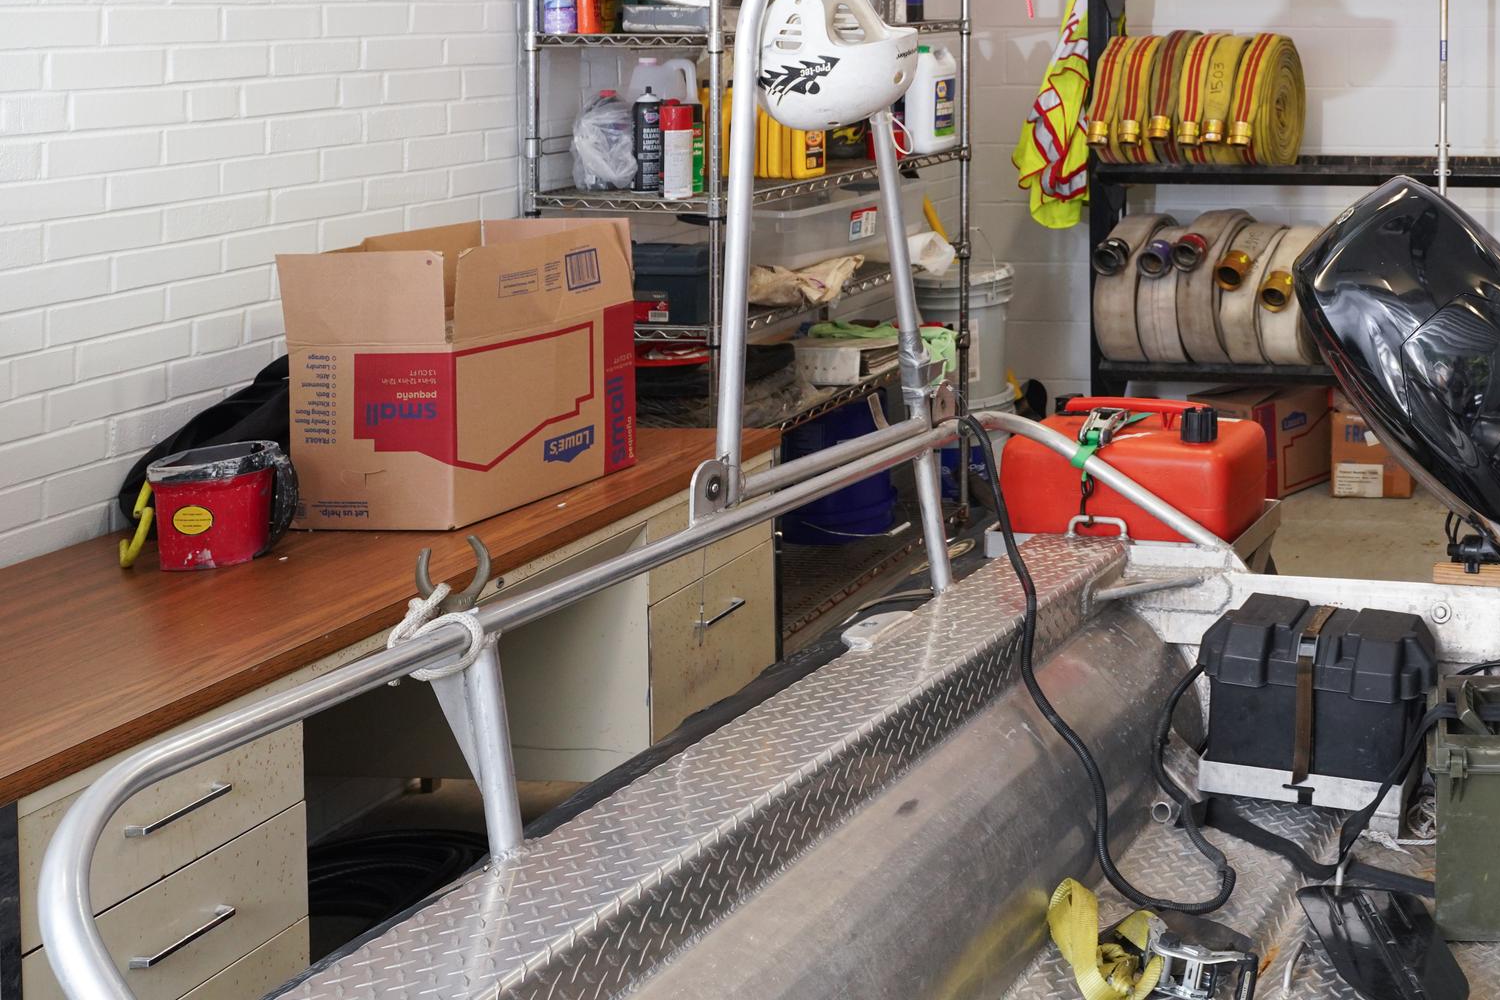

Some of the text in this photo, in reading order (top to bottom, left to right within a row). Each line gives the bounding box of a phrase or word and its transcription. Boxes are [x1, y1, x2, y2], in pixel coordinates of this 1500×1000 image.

[799, 62, 831, 78] Pro-tec
[1209, 62, 1225, 94] 1503
[307, 354, 330, 362] Garage
[306, 363, 330, 371] Laundry
[396, 390, 438, 401] pequeña
[311, 408, 330, 417] Dining
[365, 402, 438, 426] small
[311, 417, 330, 426] Family
[606, 375, 626, 464] small
[304, 427, 330, 435] Bedroom
[548, 431, 590, 455] LOWE'S
[319, 508, 369, 518] Let us help.
